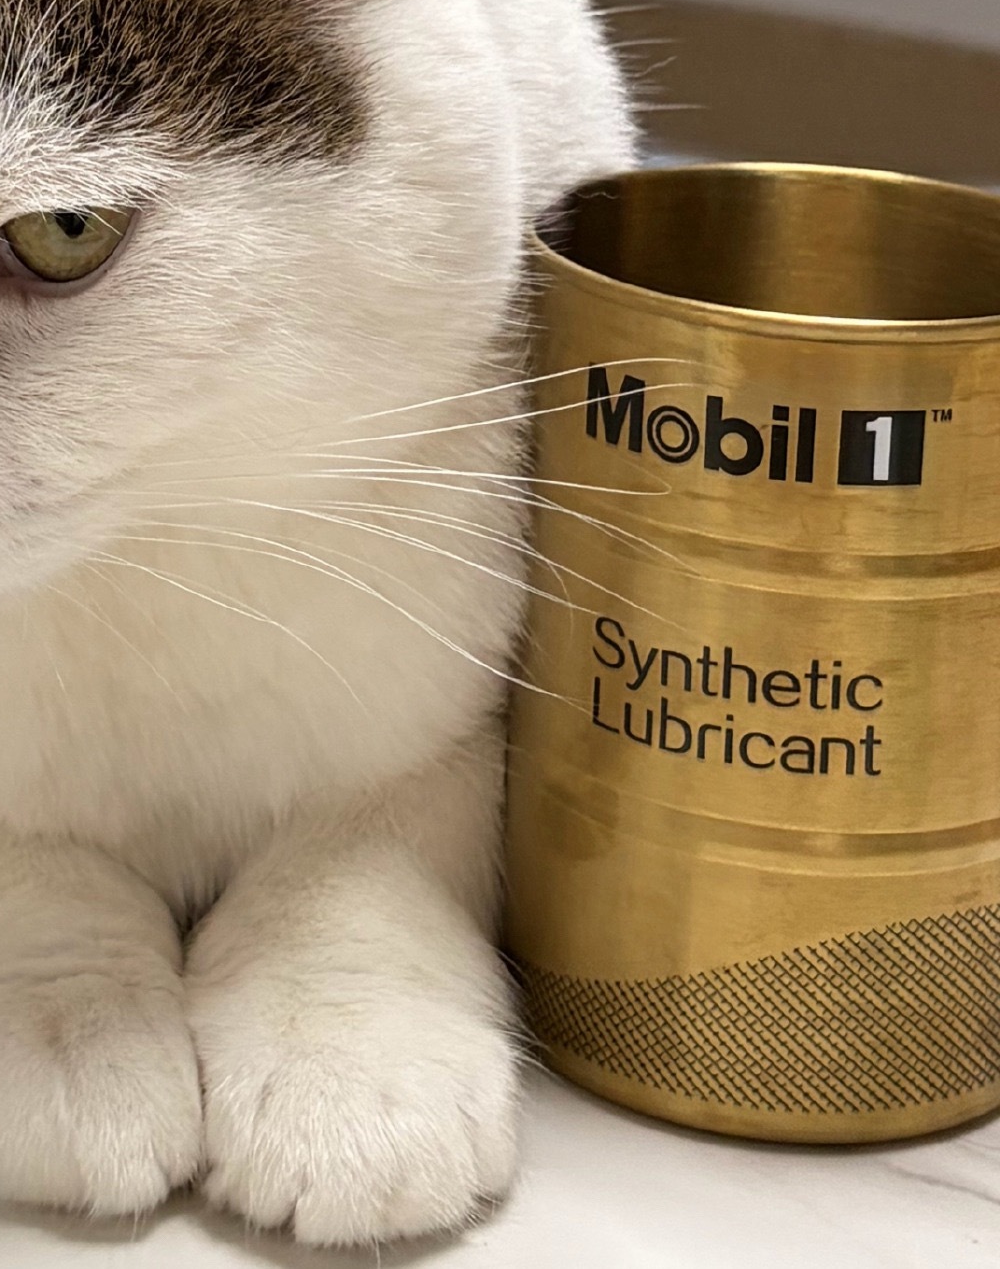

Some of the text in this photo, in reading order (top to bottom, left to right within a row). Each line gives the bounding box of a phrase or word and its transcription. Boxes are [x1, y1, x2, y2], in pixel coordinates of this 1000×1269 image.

[585, 362, 817, 484] Mobil
[592, 617, 884, 711] Synthetic
[592, 676, 883, 776] Lubricant
